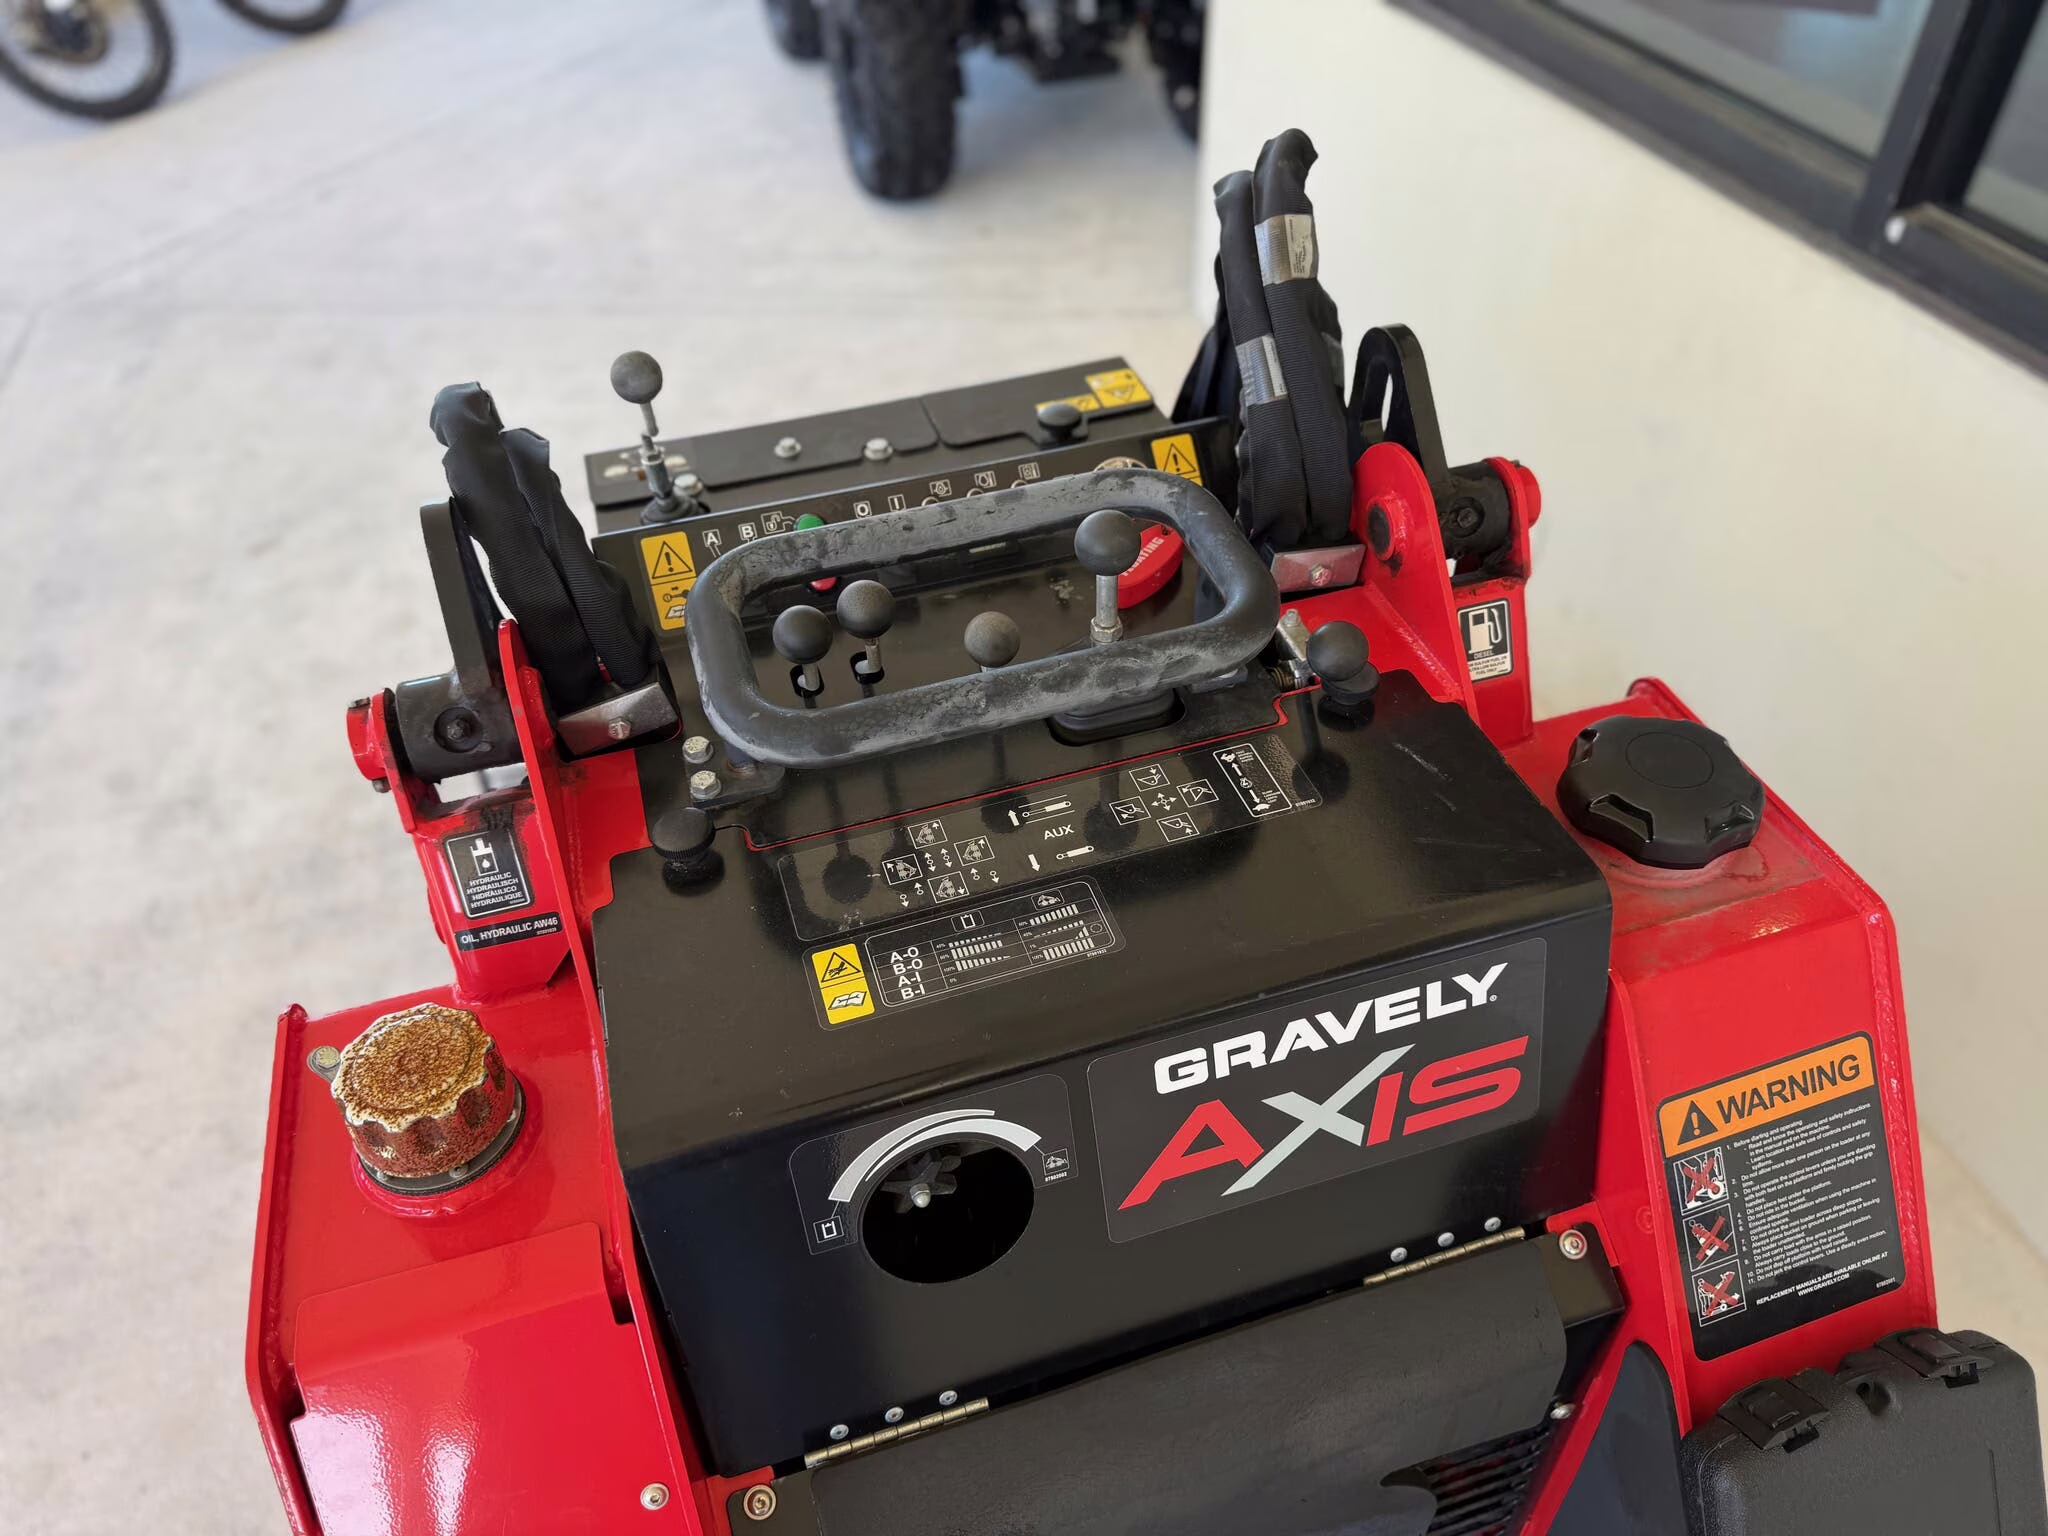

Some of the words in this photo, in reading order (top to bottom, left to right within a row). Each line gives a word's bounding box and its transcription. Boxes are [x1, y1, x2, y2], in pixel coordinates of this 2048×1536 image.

[707, 532, 718, 544] A
[742, 525, 754, 539] B
[1044, 824, 1075, 840] AUX
[467, 878, 518, 894] HYDRAULISCH
[470, 872, 512, 886] HYDRAULIC
[471, 892, 523, 908] HYDRAULIQUE
[472, 886, 517, 900] HIDRAULICO
[480, 923, 532, 941] HYDRAULIC
[534, 917, 558, 929] AW46
[1154, 963, 1508, 1094] GRAVELY
[1716, 1054, 1860, 1124] WARNING
[1118, 1035, 1529, 1210] AXIS
[1757, 1286, 1795, 1304] REPLACEMENT
[1796, 1277, 1821, 1292] MANUALS
[1822, 1272, 1833, 1282] ARE
[1834, 1262, 1861, 1276] AVAILABLE
[1862, 1254, 1880, 1265] ONLINE
[1798, 1273, 1849, 1296] WWW.GRAVELY.COM
